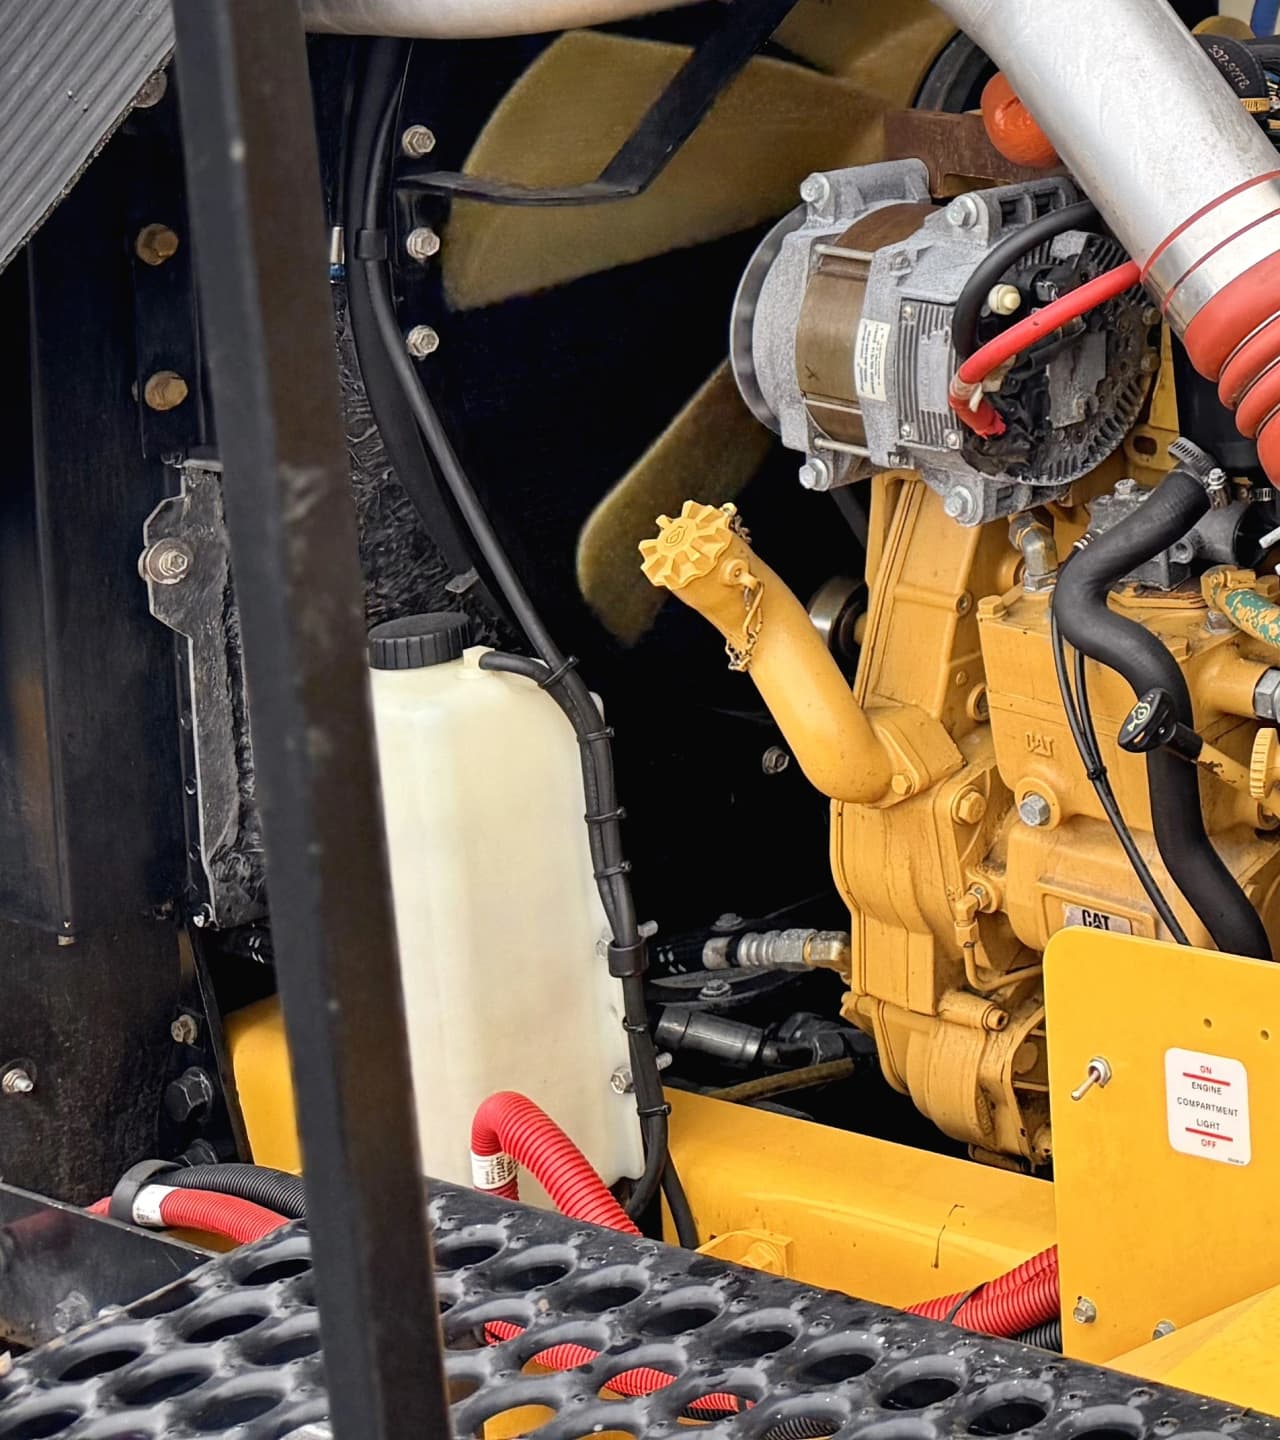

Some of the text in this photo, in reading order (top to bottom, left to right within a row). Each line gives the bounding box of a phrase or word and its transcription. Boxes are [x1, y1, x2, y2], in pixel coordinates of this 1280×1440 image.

[1081, 908, 1110, 931] CAT
[1200, 1065, 1212, 1074] ON
[1191, 1081, 1222, 1095] ENGINE
[1177, 1096, 1238, 1117] COMPARTMENT
[1196, 1118, 1220, 1131] LIGHT
[1201, 1138, 1216, 1148] OFF
